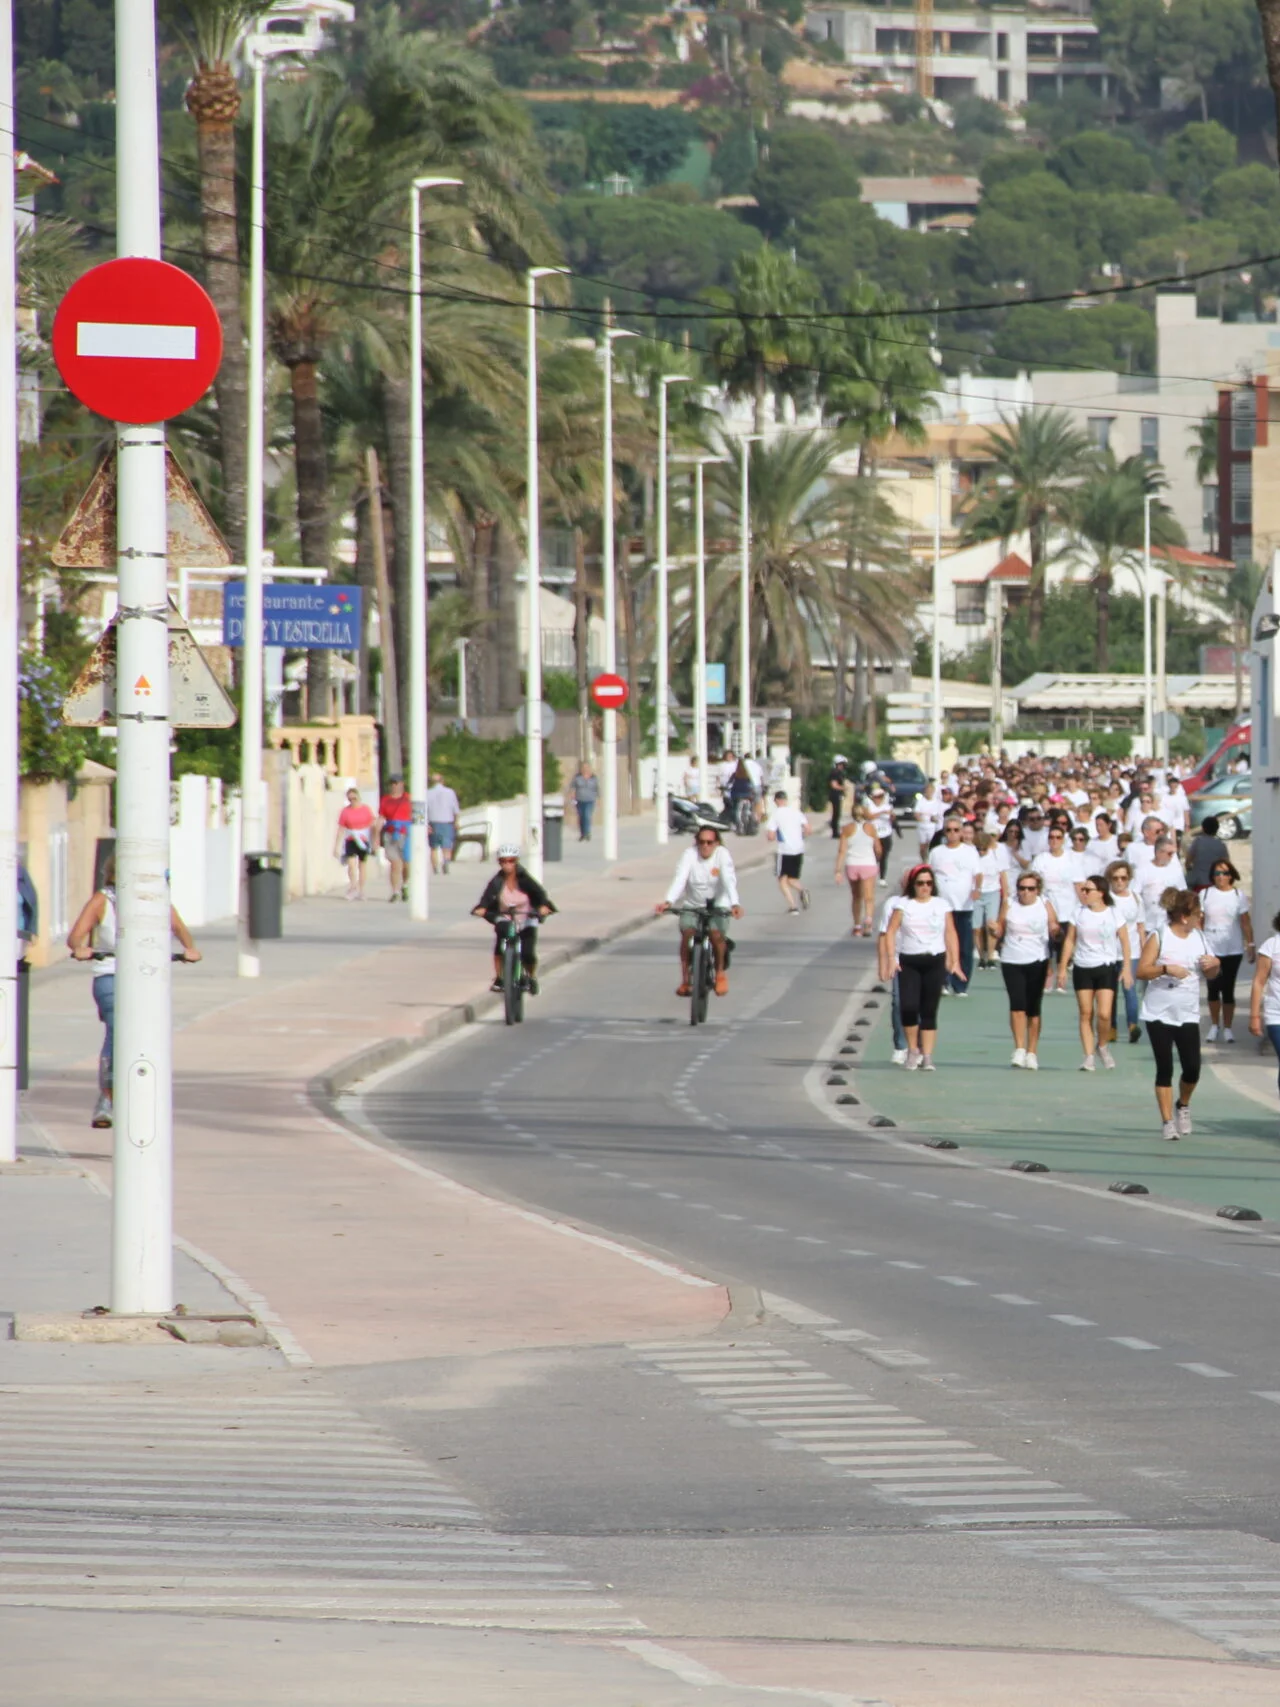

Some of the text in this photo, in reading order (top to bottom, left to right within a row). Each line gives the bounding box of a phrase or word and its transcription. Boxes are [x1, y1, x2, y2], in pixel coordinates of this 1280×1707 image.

[229, 594, 325, 611] reaurante
[272, 619, 281, 642] Y
[284, 619, 352, 645] ESTRELLA
